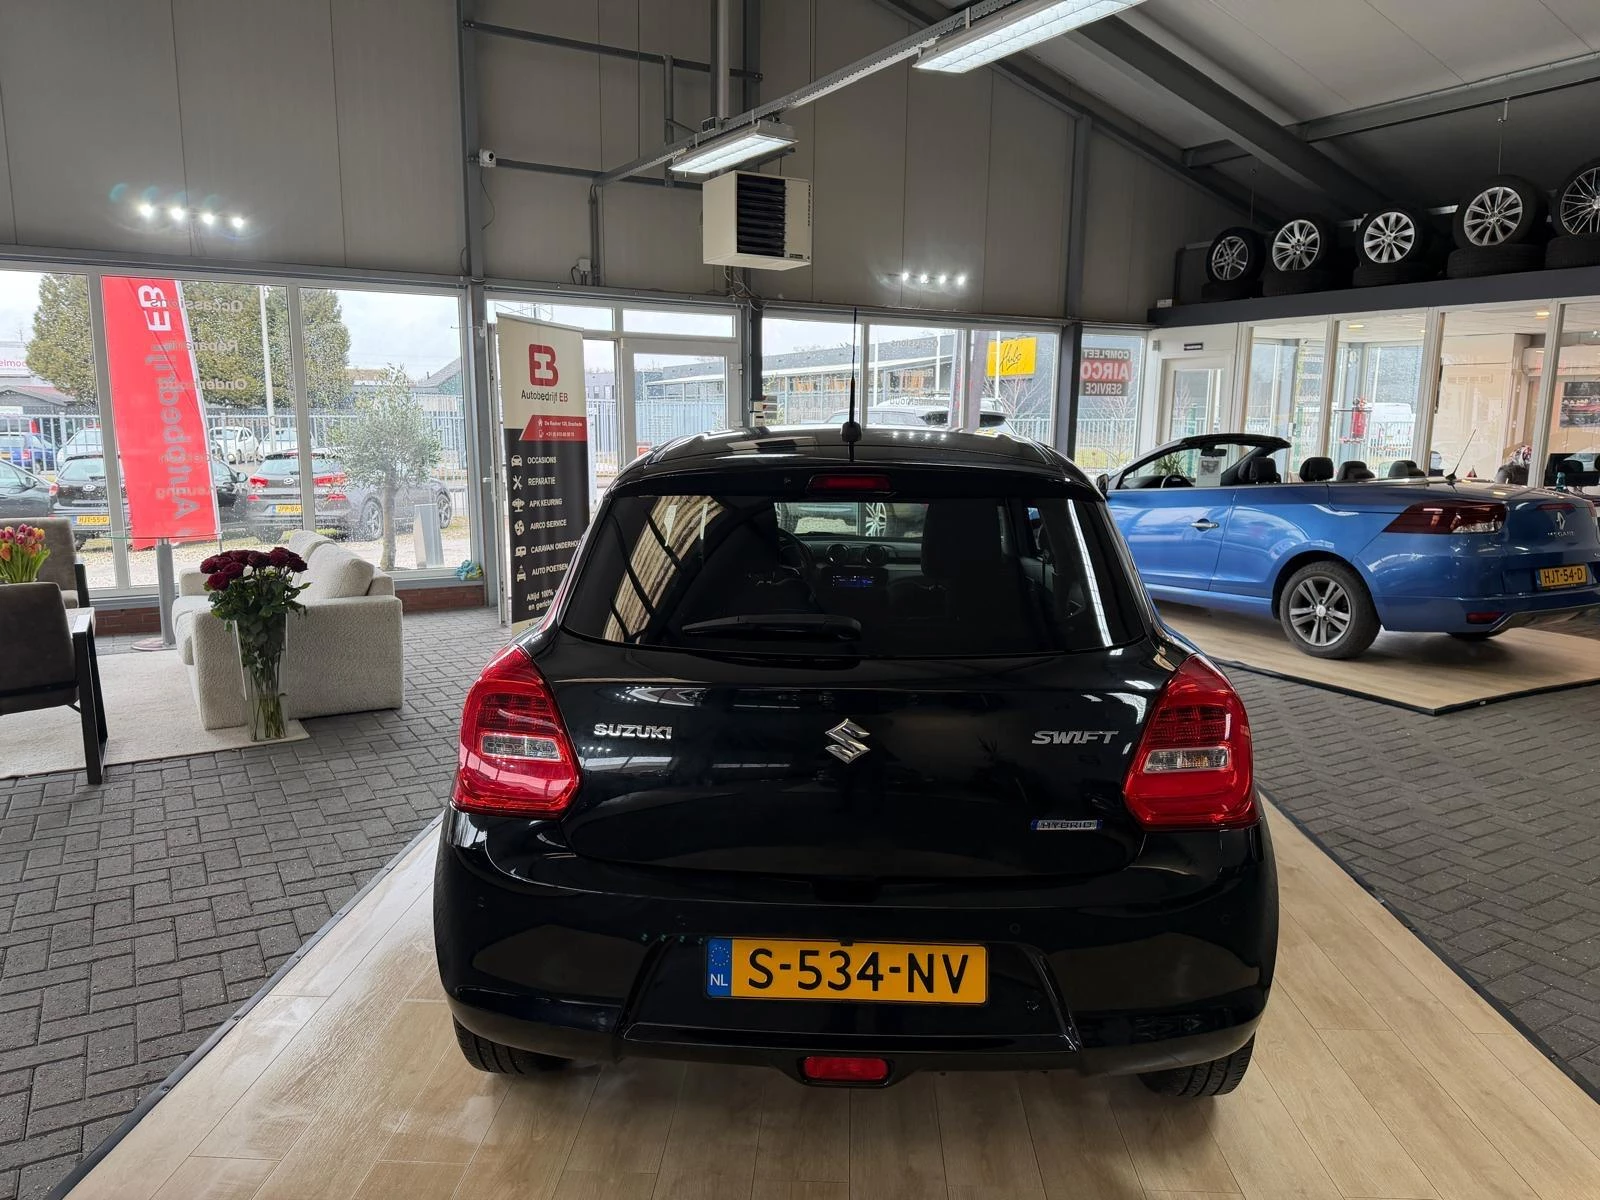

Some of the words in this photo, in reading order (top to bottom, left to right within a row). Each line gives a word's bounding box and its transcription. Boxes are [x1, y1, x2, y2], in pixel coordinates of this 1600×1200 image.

[521, 389, 558, 404] Autobedrijf
[559, 391, 569, 403] EB
[527, 456, 557, 464] OCCASIONS
[527, 476, 556, 486] REPARATIE
[530, 521, 546, 530] AIRCO
[546, 519, 567, 528] SERVICE
[530, 543, 555, 554] CARAVAN
[532, 567, 546, 576] AUTO
[1543, 567, 1583, 585] HJT-54-D
[594, 723, 673, 740] SUZUKI
[1031, 730, 1120, 745] SWIFT
[1040, 820, 1097, 830] HYBRID
[710, 974, 728, 987] NL
[748, 947, 969, 994] S-534-NV
